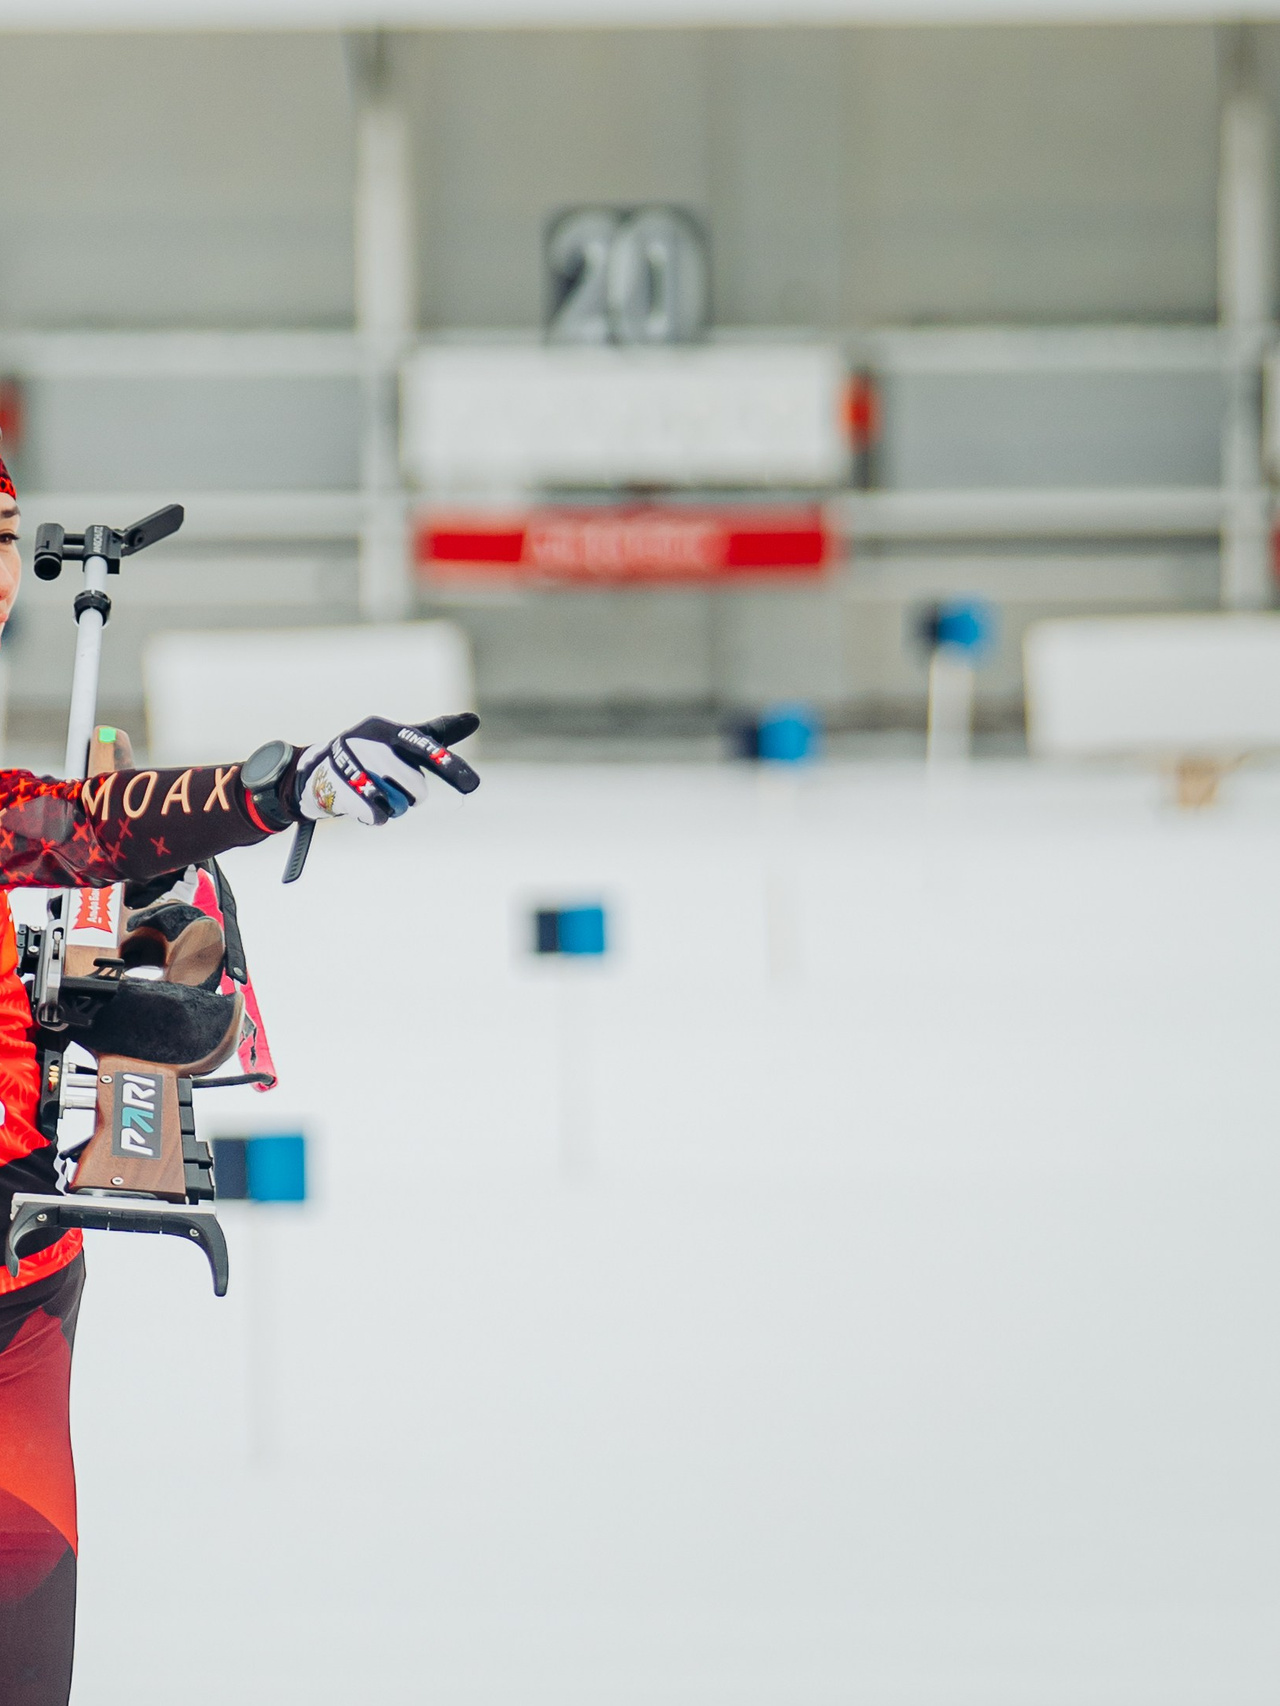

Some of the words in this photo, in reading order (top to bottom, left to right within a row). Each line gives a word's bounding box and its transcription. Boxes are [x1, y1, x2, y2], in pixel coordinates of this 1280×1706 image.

[548, 210, 703, 345] 20
[81, 764, 239, 821] MOAX
[120, 1073, 156, 1157] PARI
